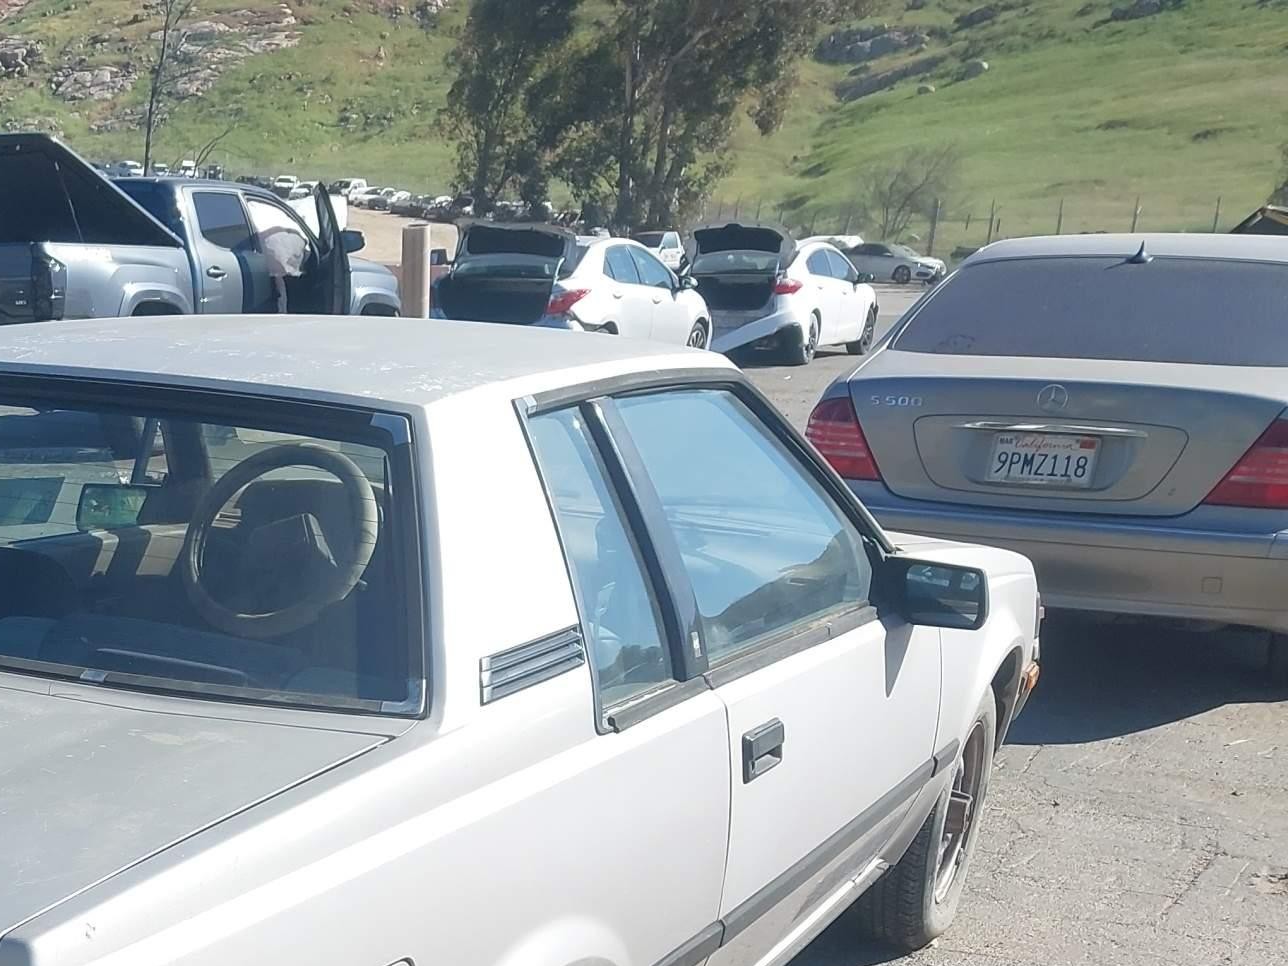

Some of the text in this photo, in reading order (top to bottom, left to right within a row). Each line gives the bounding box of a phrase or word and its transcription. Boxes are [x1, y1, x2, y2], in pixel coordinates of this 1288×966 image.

[886, 395, 922, 406] 500
[1015, 438, 1074, 452] California
[993, 451, 1089, 479] 9PMZ118
